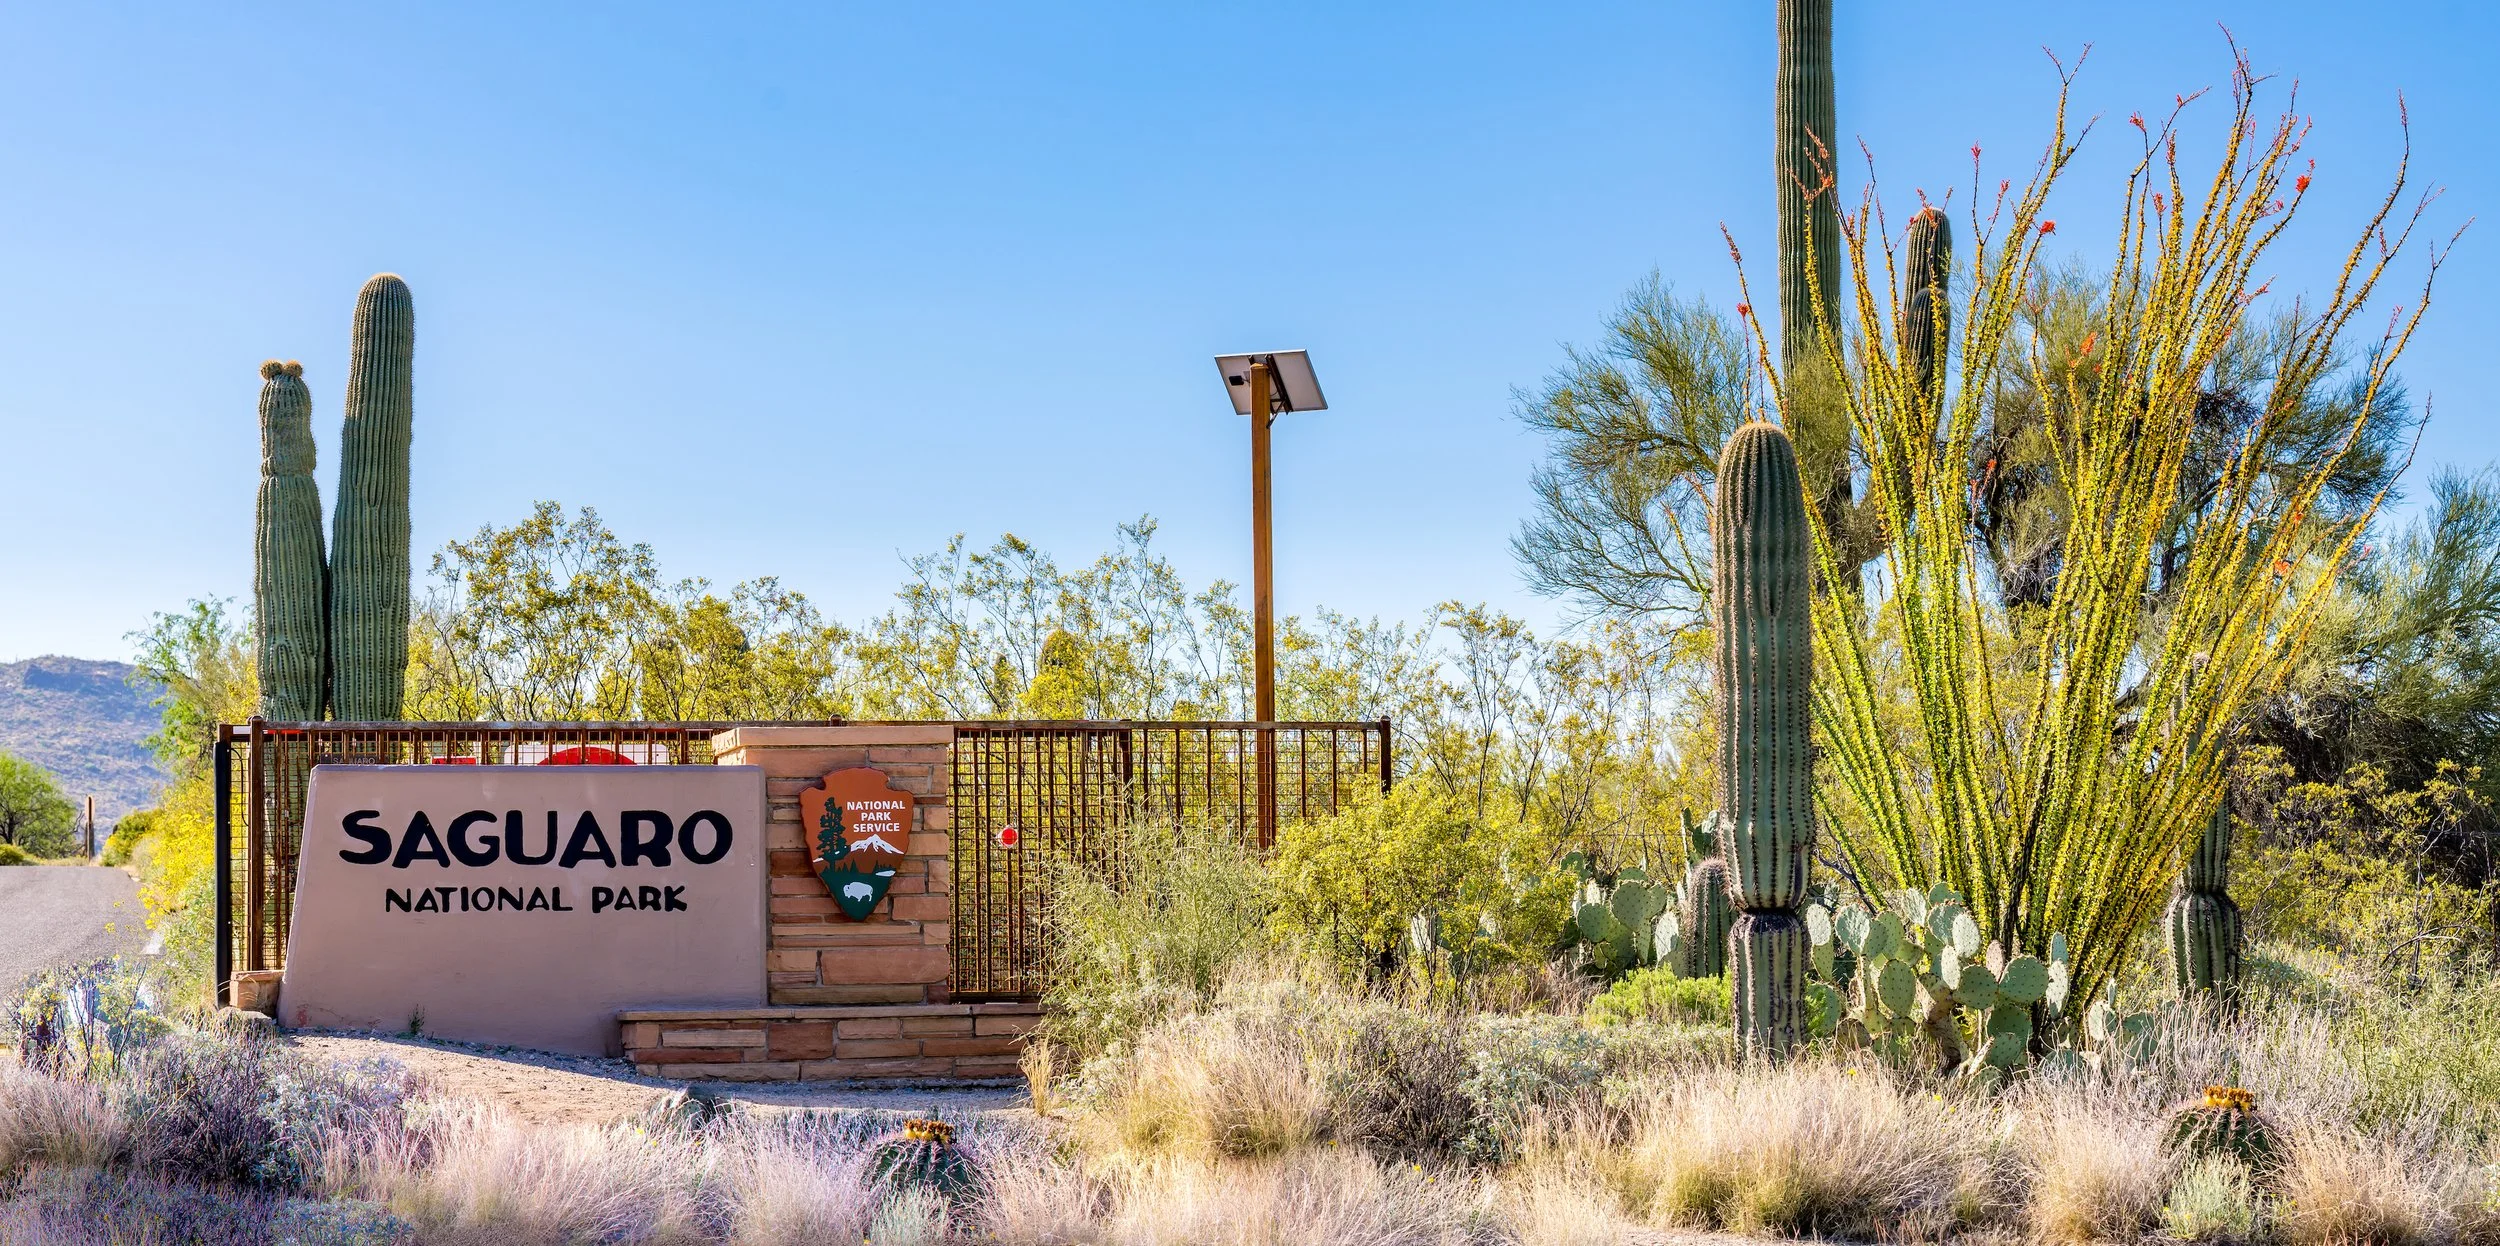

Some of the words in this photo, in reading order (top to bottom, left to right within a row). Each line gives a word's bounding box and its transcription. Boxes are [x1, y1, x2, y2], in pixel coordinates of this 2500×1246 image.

[846, 800, 906, 811] NATIONAL
[861, 811, 892, 822] PARK
[853, 822, 900, 833] SERVICE
[339, 810, 733, 868] SAGUARO
[386, 886, 573, 913] NATIONAL
[592, 886, 688, 913] PARK
